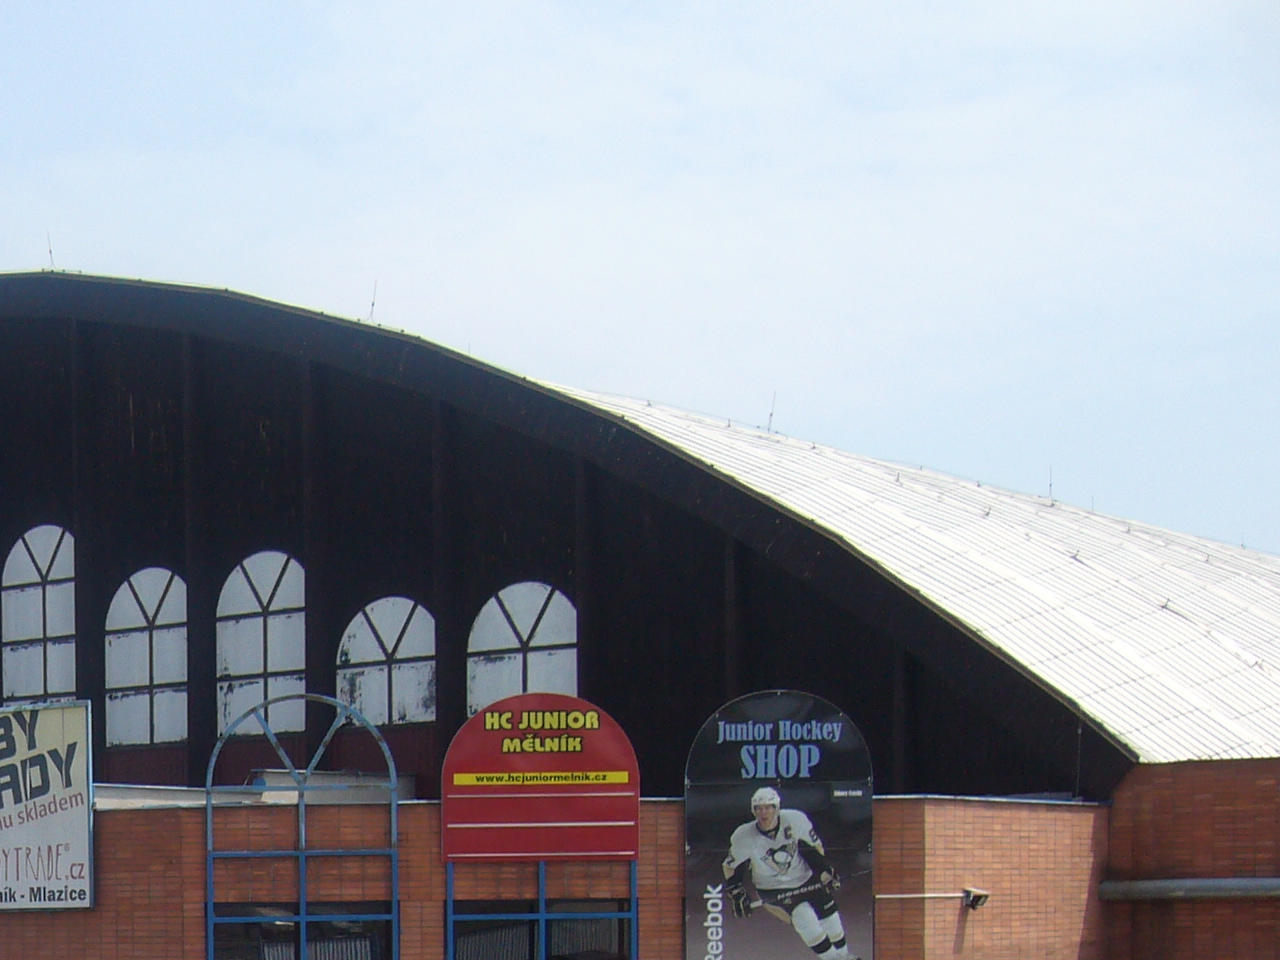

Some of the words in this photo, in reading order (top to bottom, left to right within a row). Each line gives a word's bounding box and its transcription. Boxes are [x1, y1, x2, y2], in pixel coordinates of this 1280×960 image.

[484, 711, 513, 730] HC
[518, 710, 600, 730] JUNIOR
[717, 720, 773, 744] Junior
[778, 719, 843, 743] Hockey
[502, 733, 583, 753] MĚLNÍK
[740, 744, 820, 779] SHOP
[475, 773, 607, 784] www.hcjuniormelnik.cz
[17, 792, 85, 825] skladem
[28, 885, 87, 903] Mlazice
